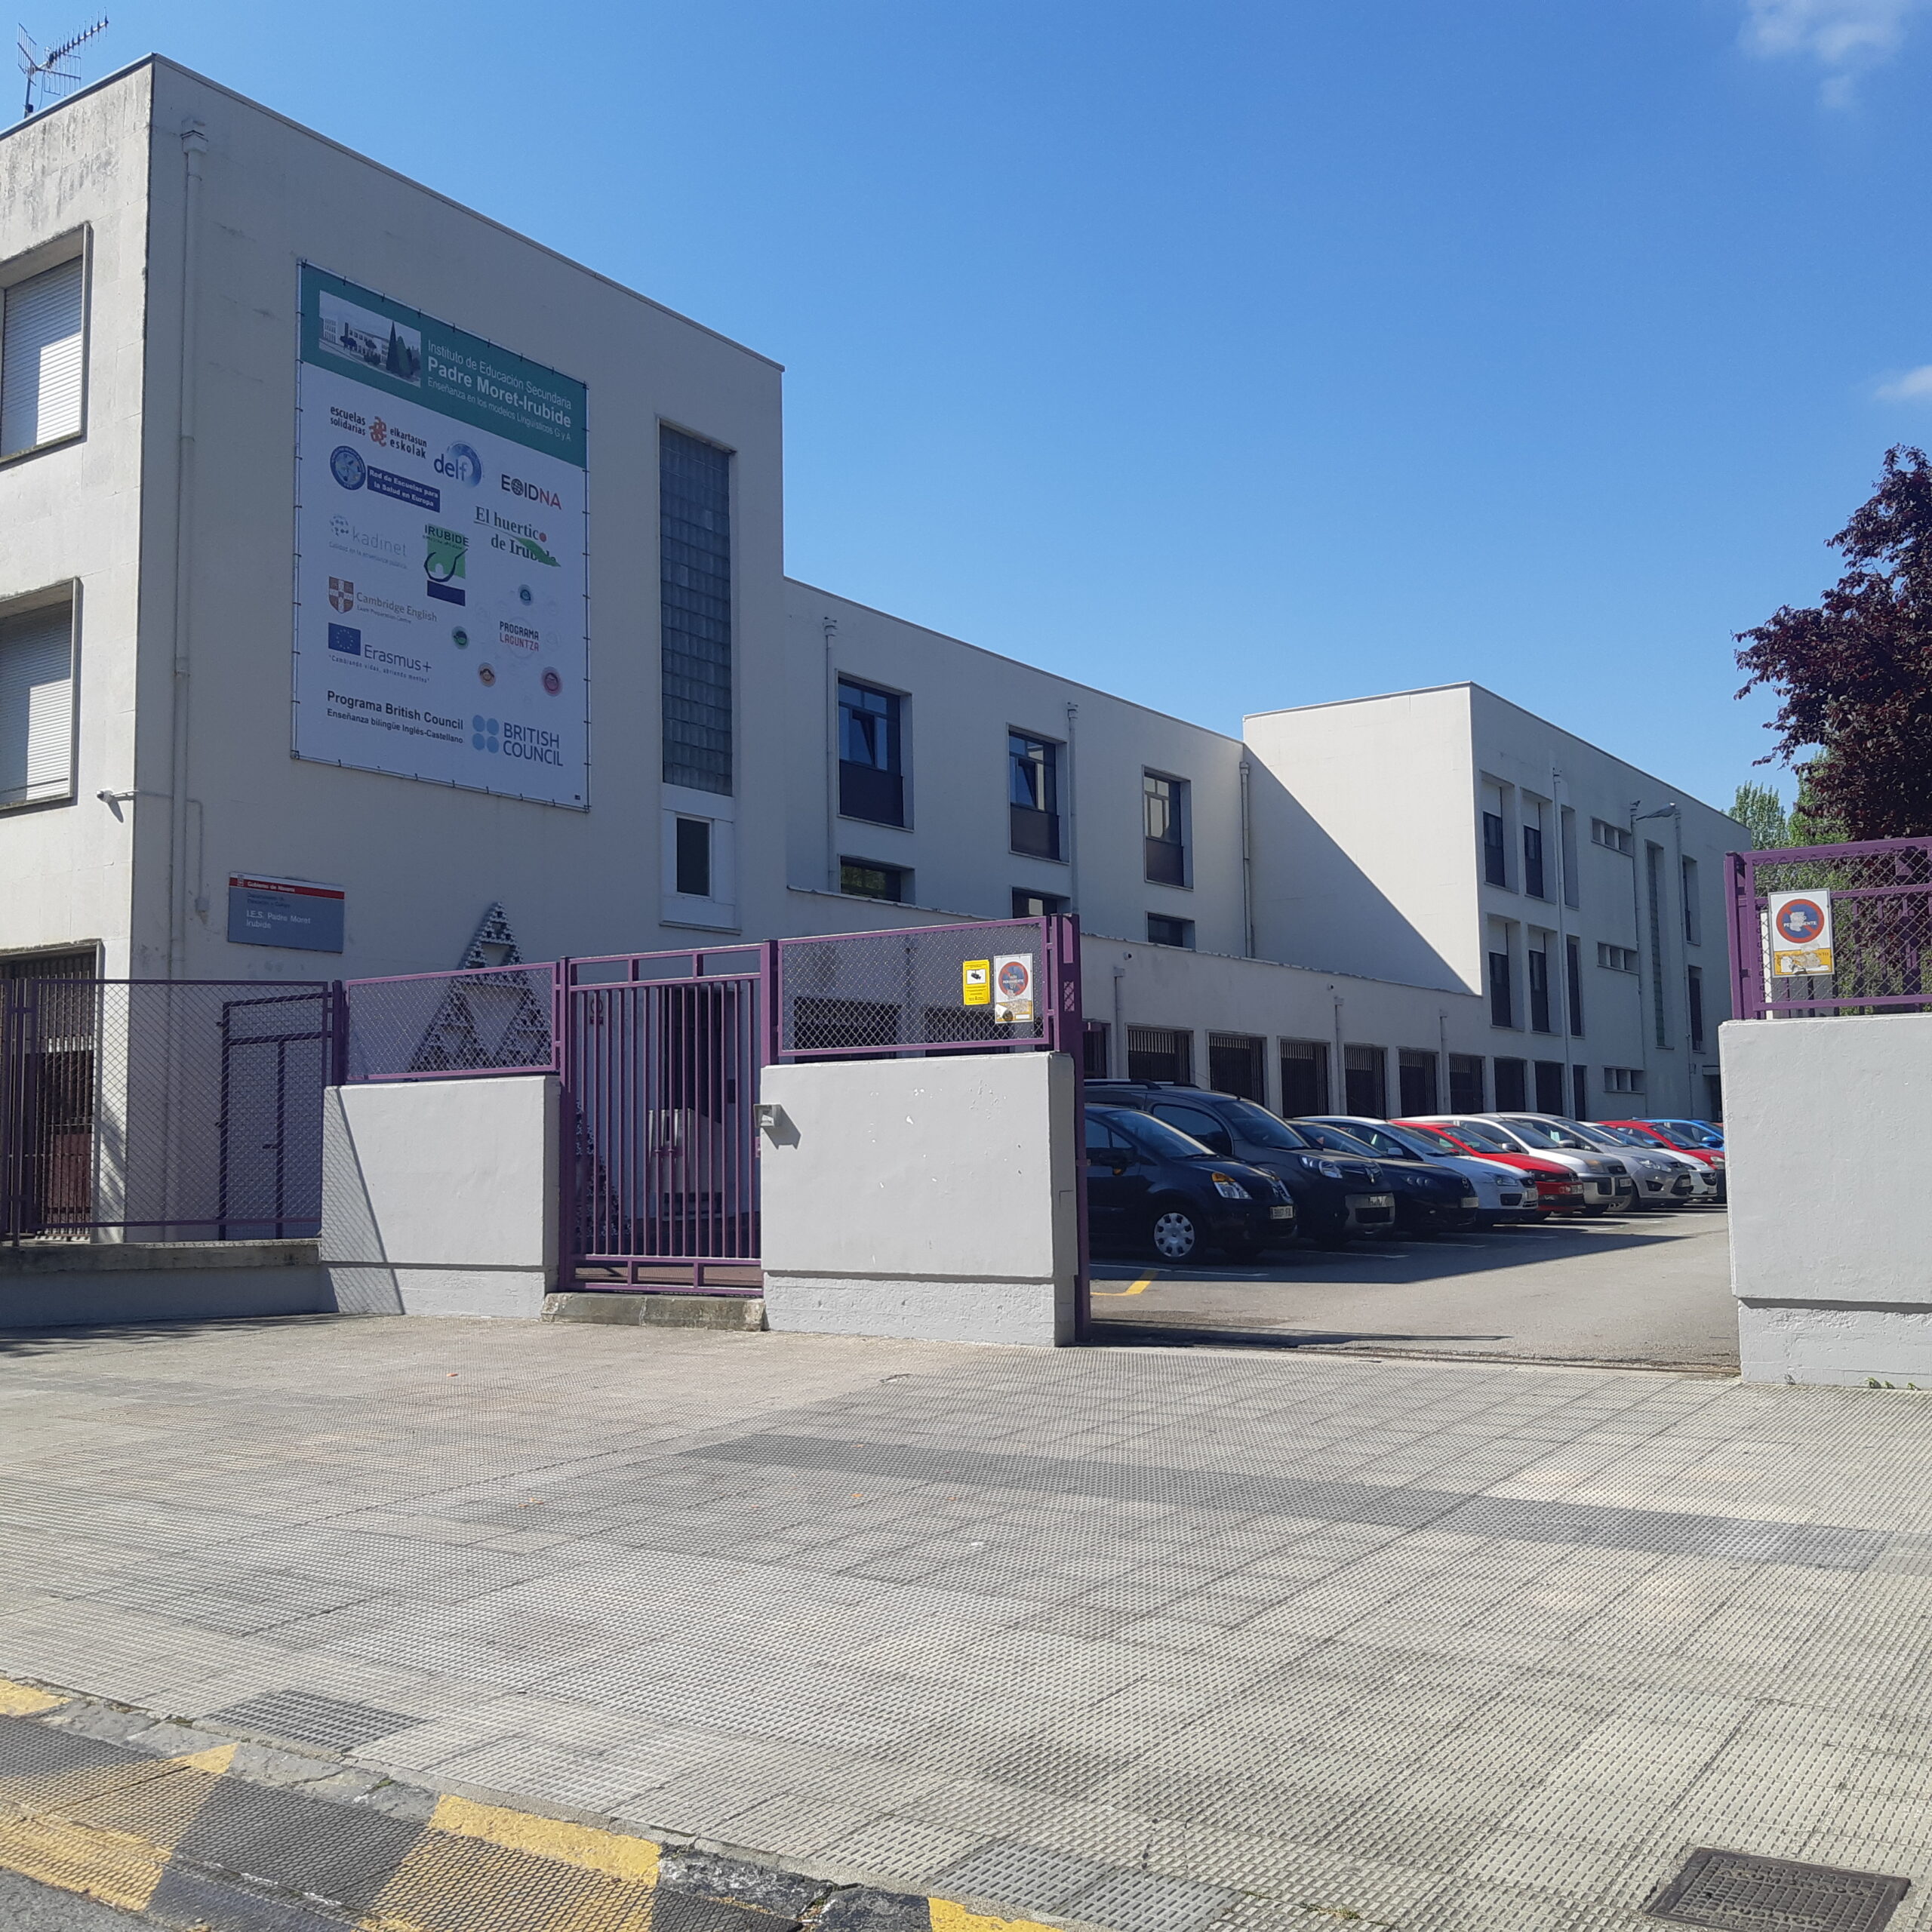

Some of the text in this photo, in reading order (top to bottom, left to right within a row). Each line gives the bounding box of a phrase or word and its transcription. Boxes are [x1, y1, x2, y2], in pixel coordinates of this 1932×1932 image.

[428, 340, 571, 409] Instituto de Educación Secundaria
[428, 355, 571, 428] Padre Moret-Irubide
[331, 406, 366, 426] escuelas
[331, 417, 366, 436] solidarias
[390, 427, 427, 448] elkartasun
[390, 438, 426, 459] eskolak
[475, 506, 489, 524] El
[425, 524, 469, 547] IRUBIDE
[491, 534, 506, 551] de
[356, 591, 437, 622] Cambridge English
[500, 620, 539, 641] PROGRAMA
[500, 632, 539, 652] LAGUNTZA
[365, 644, 432, 673] Erasmus+
[327, 690, 463, 730] Programa British Council
[327, 708, 463, 744] Enseñanza bilingüe Inglés-Castellano
[504, 722, 559, 749] BRITISH
[503, 740, 564, 767] COUNCIL
[247, 918, 271, 929] Irubide
[268, 912, 288, 921] Padre
[291, 915, 311, 924] Moret
